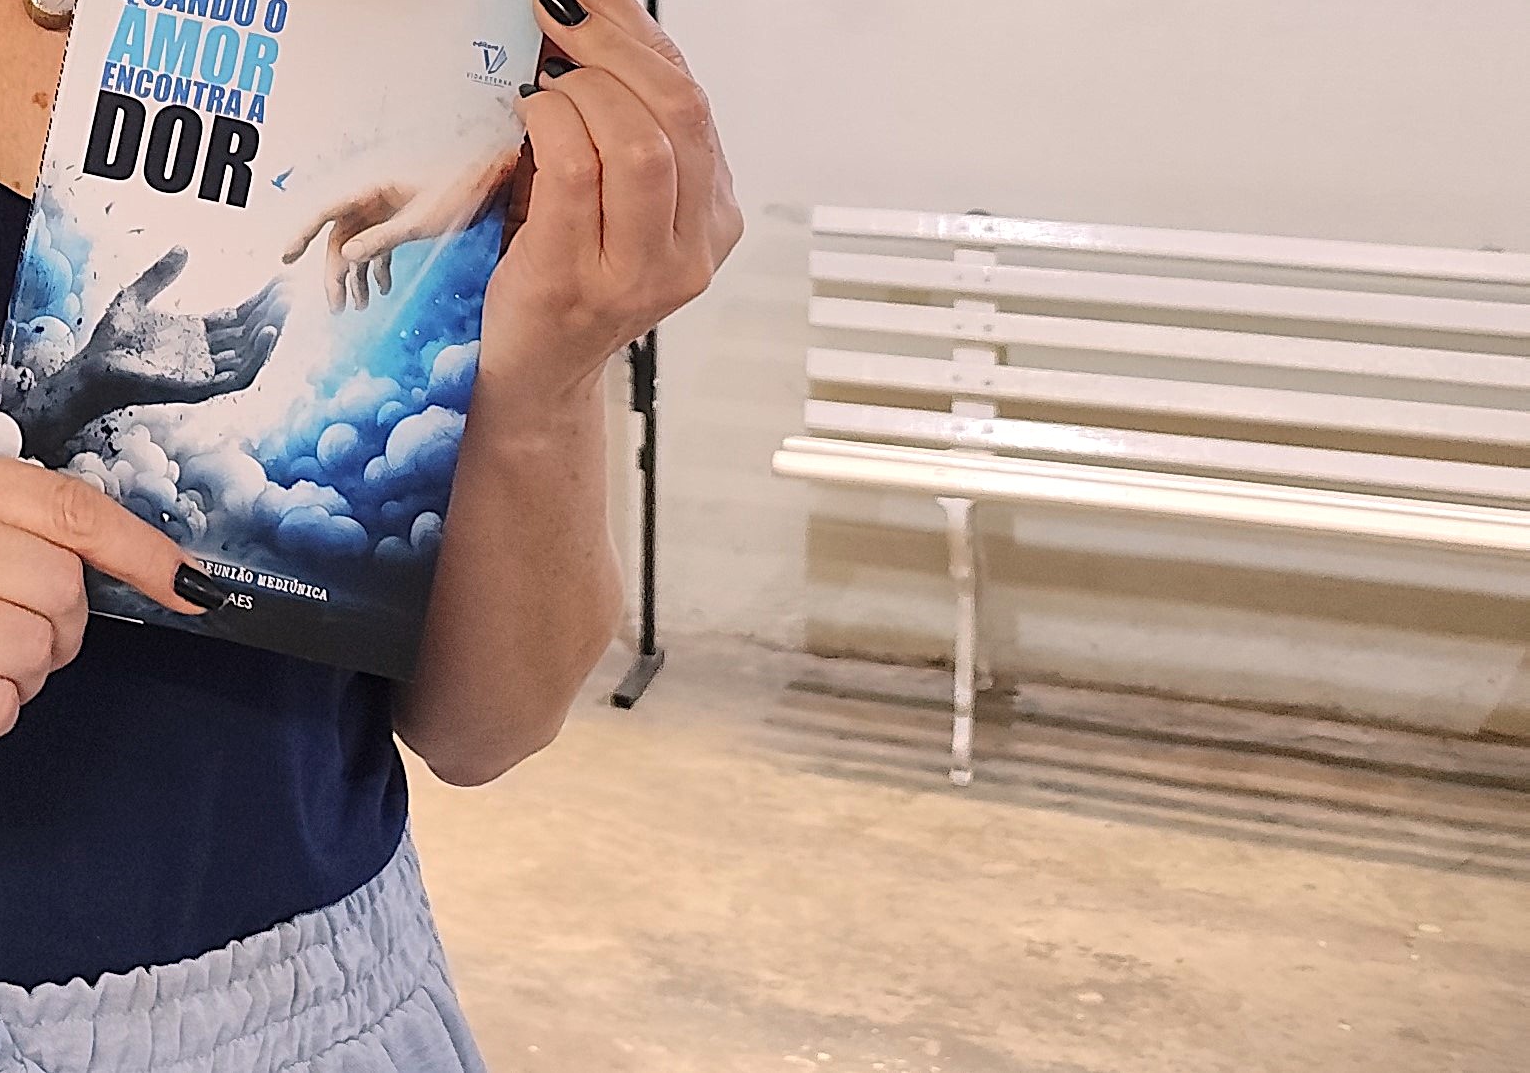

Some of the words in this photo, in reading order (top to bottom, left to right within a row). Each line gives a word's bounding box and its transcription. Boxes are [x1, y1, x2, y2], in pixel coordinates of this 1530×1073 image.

[107, 4, 280, 97] AMOR
[101, 61, 242, 119] ENCONTRA
[246, 93, 266, 125] A
[82, 89, 261, 210] DOR
[257, 573, 329, 603] MEDIÚNICA
